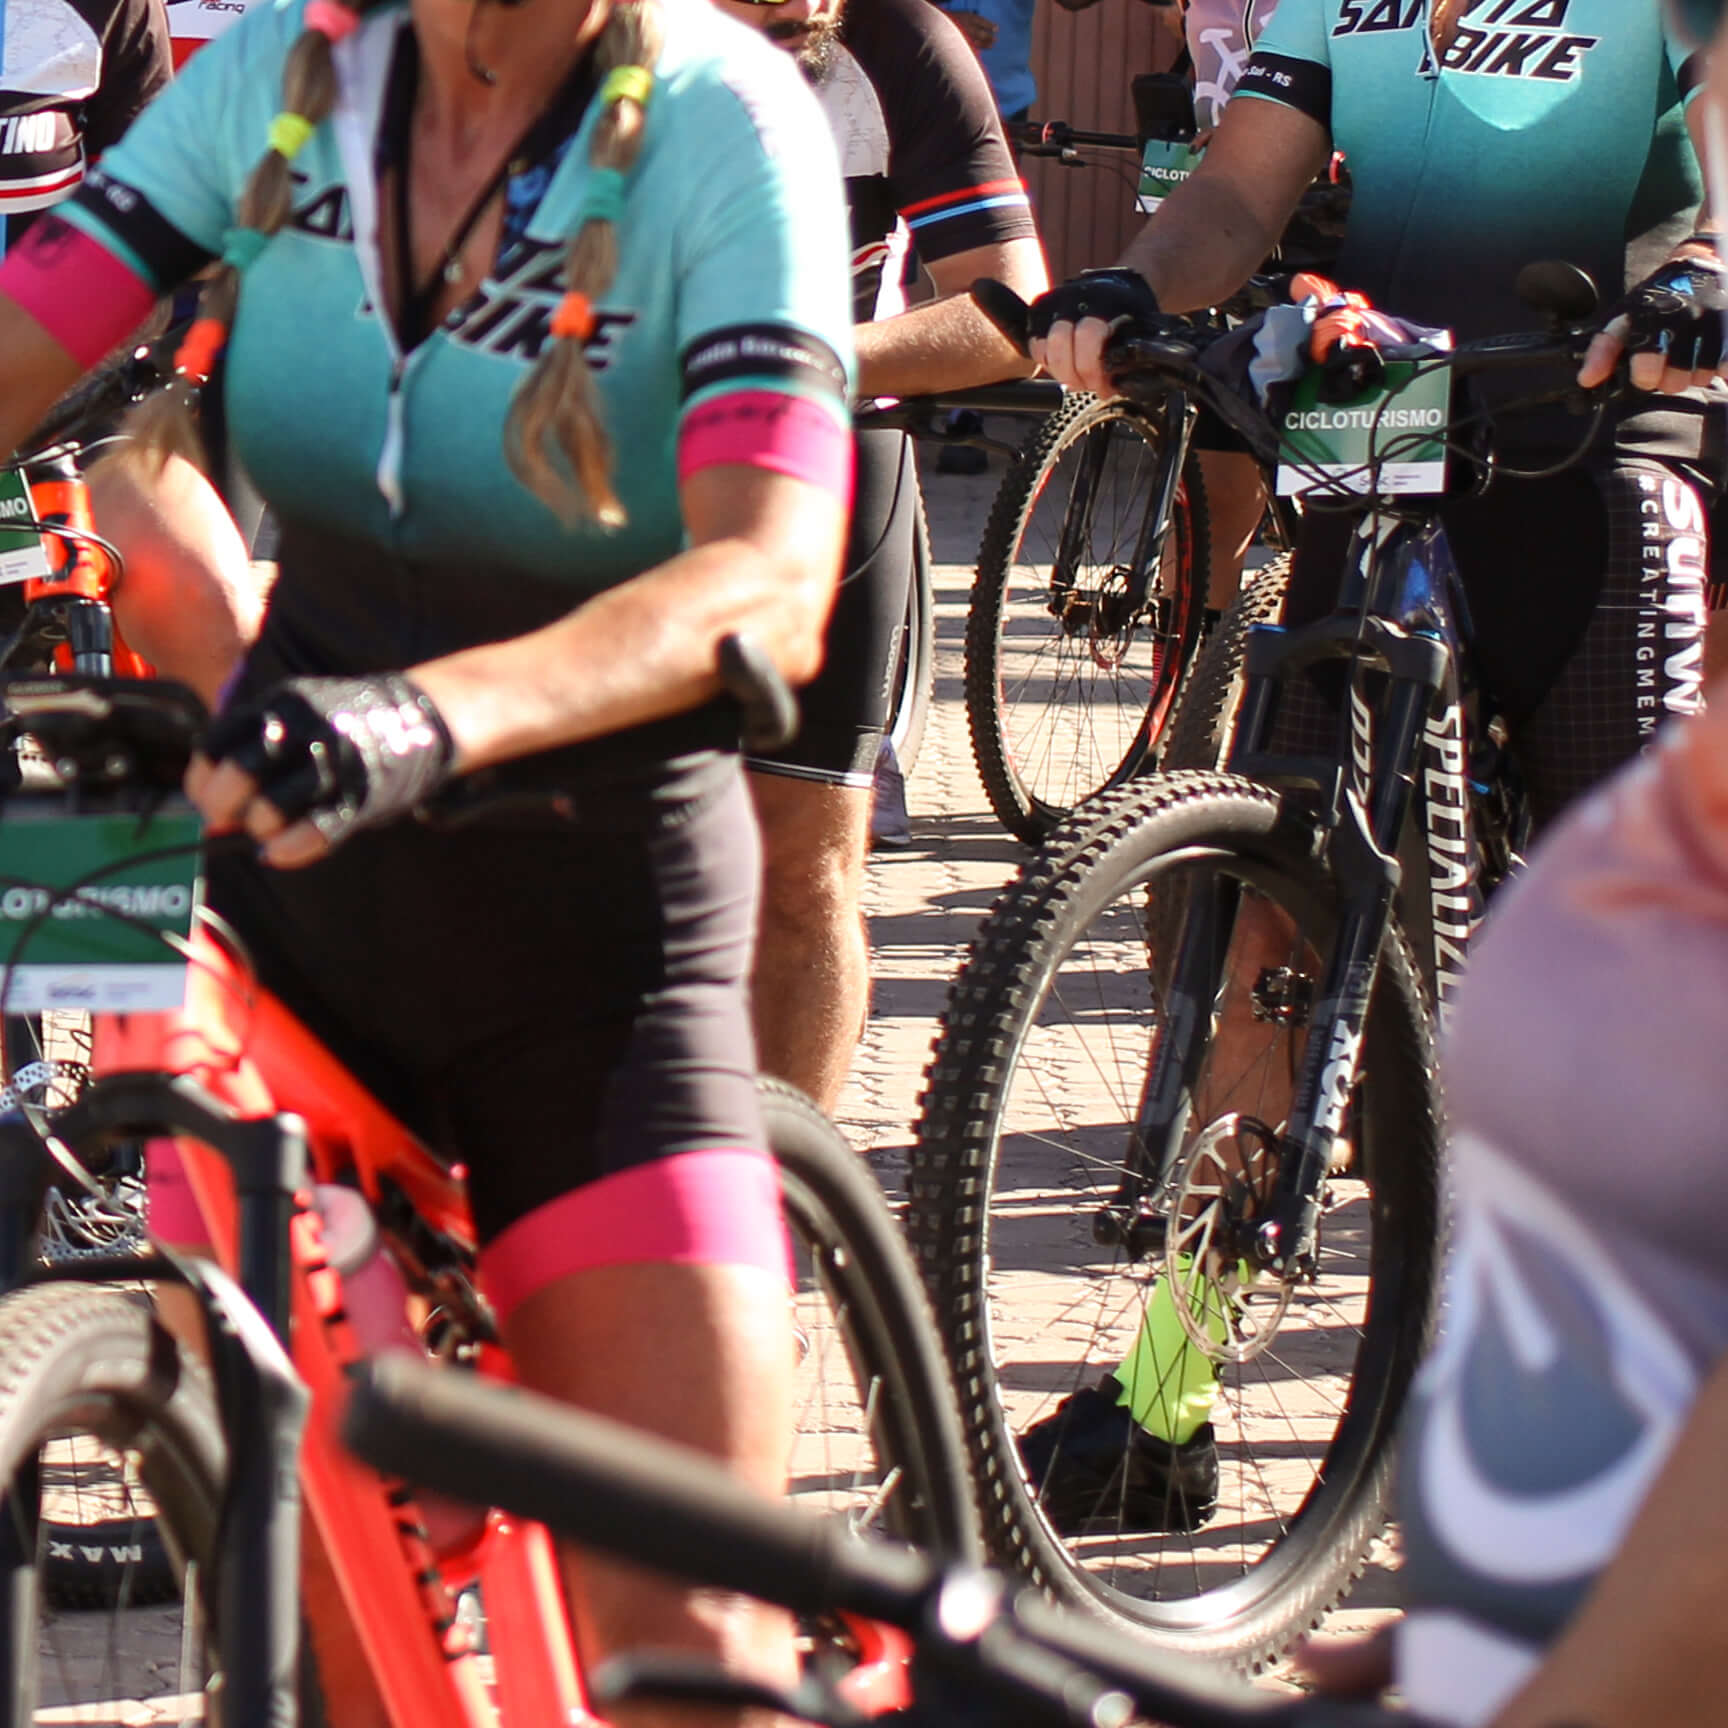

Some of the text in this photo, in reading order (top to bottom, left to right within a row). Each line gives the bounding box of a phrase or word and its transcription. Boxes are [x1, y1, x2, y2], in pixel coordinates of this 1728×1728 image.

[1417, 27, 1600, 81] BIKE
[1272, 71, 1293, 88] RS
[1285, 408, 1443, 430] CICLOTURISMO
[1313, 1018, 1363, 1134] FOX
